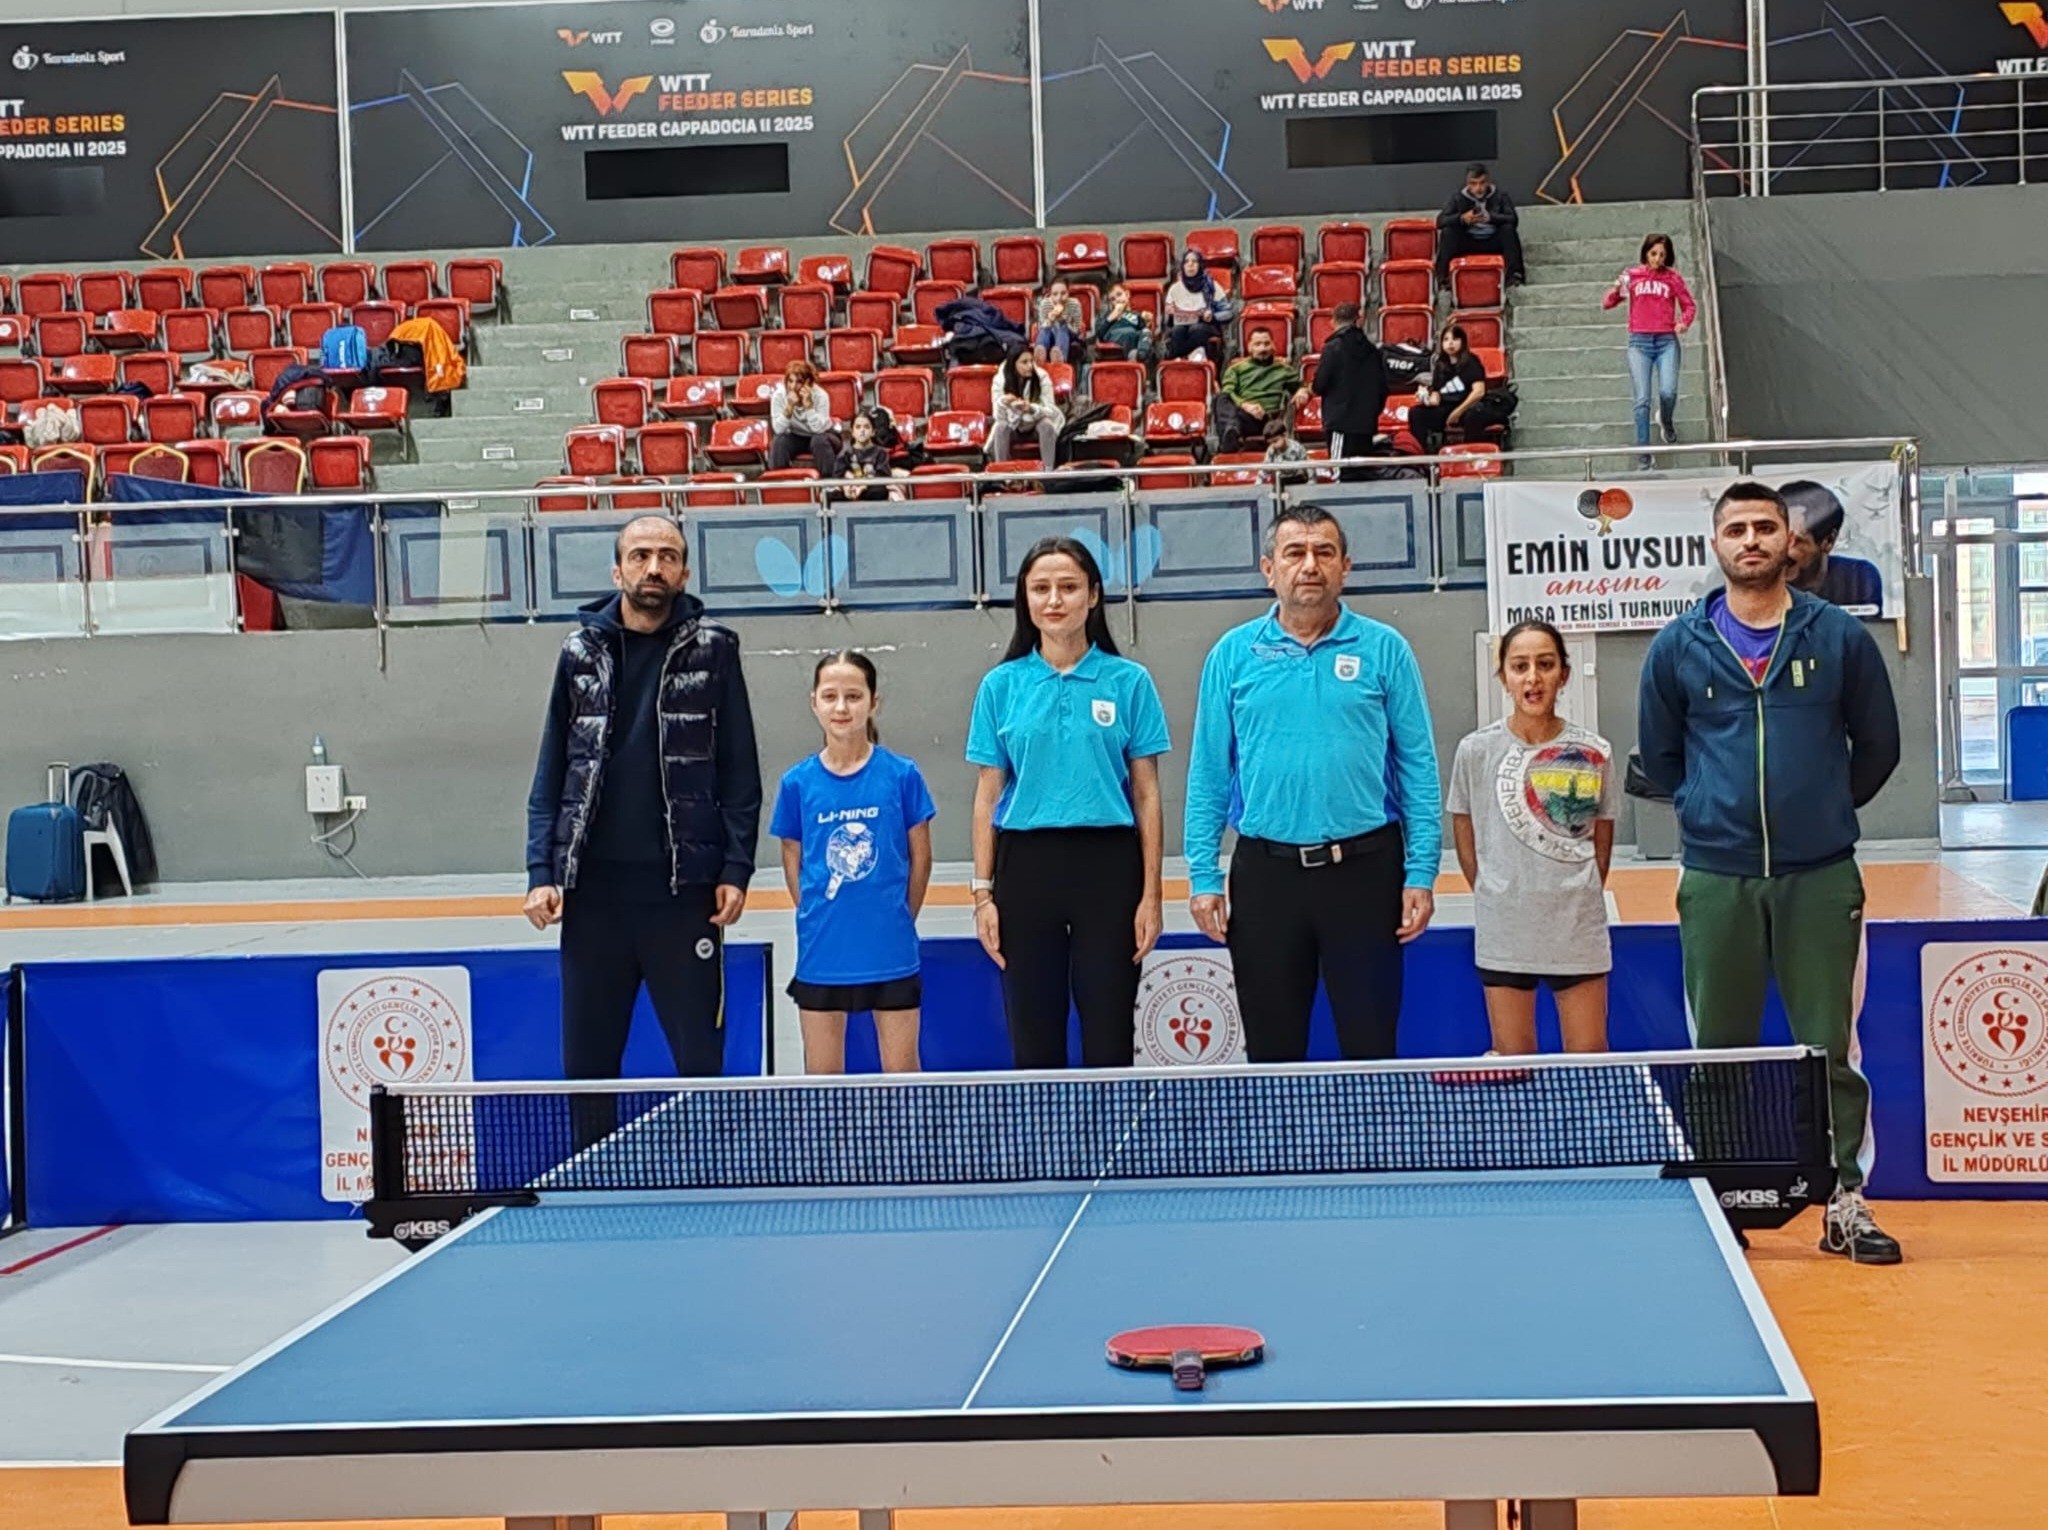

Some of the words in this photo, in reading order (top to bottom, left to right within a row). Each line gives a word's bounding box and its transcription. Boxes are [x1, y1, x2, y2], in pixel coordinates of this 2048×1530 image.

[591, 31, 623, 44] WTT
[786, 23, 814, 38] Sport
[97, 50, 125, 65] Sport
[1362, 40, 1416, 59] WTT
[1361, 57, 1442, 78] FEEDER
[1447, 54, 1521, 75] SERIES
[1996, 58, 2034, 75] WTT
[659, 74, 711, 91] WTT
[659, 90, 737, 111] FEEDER
[741, 88, 813, 108] SERIES
[1261, 94, 1295, 110] WTT
[1298, 90, 1359, 108] FEEDER
[1362, 86, 1463, 105] CAPPADOCIA
[1481, 84, 1522, 100] 2025
[0, 99, 24, 117] TT
[0, 117, 50, 135] EDER
[55, 114, 125, 134] SERIES
[562, 125, 595, 140] WTT
[598, 122, 657, 139] FEEDER
[660, 118, 756, 137] CAPPADOCIA
[774, 116, 814, 132] 2025
[87, 140, 127, 157] 2025
[1507, 534, 1589, 575] EMİN
[1602, 534, 1706, 571] UYSUN
[1545, 574, 1670, 596] anısına
[1507, 605, 1555, 624] MASA
[1562, 598, 1613, 622] TENİSİ
[817, 806, 879, 824] LI-NING
[1930, 1129, 2007, 1151] GENÇLİK
[2013, 1132, 2035, 1147] VE
[326, 1153, 370, 1170] GENÇ
[1943, 1154, 1958, 1172] İL
[1964, 1154, 2048, 1172] MÜDÜRLÜ
[337, 1174, 352, 1191] İL
[1736, 1190, 1779, 1204] KBS
[410, 1220, 450, 1235] KBS
